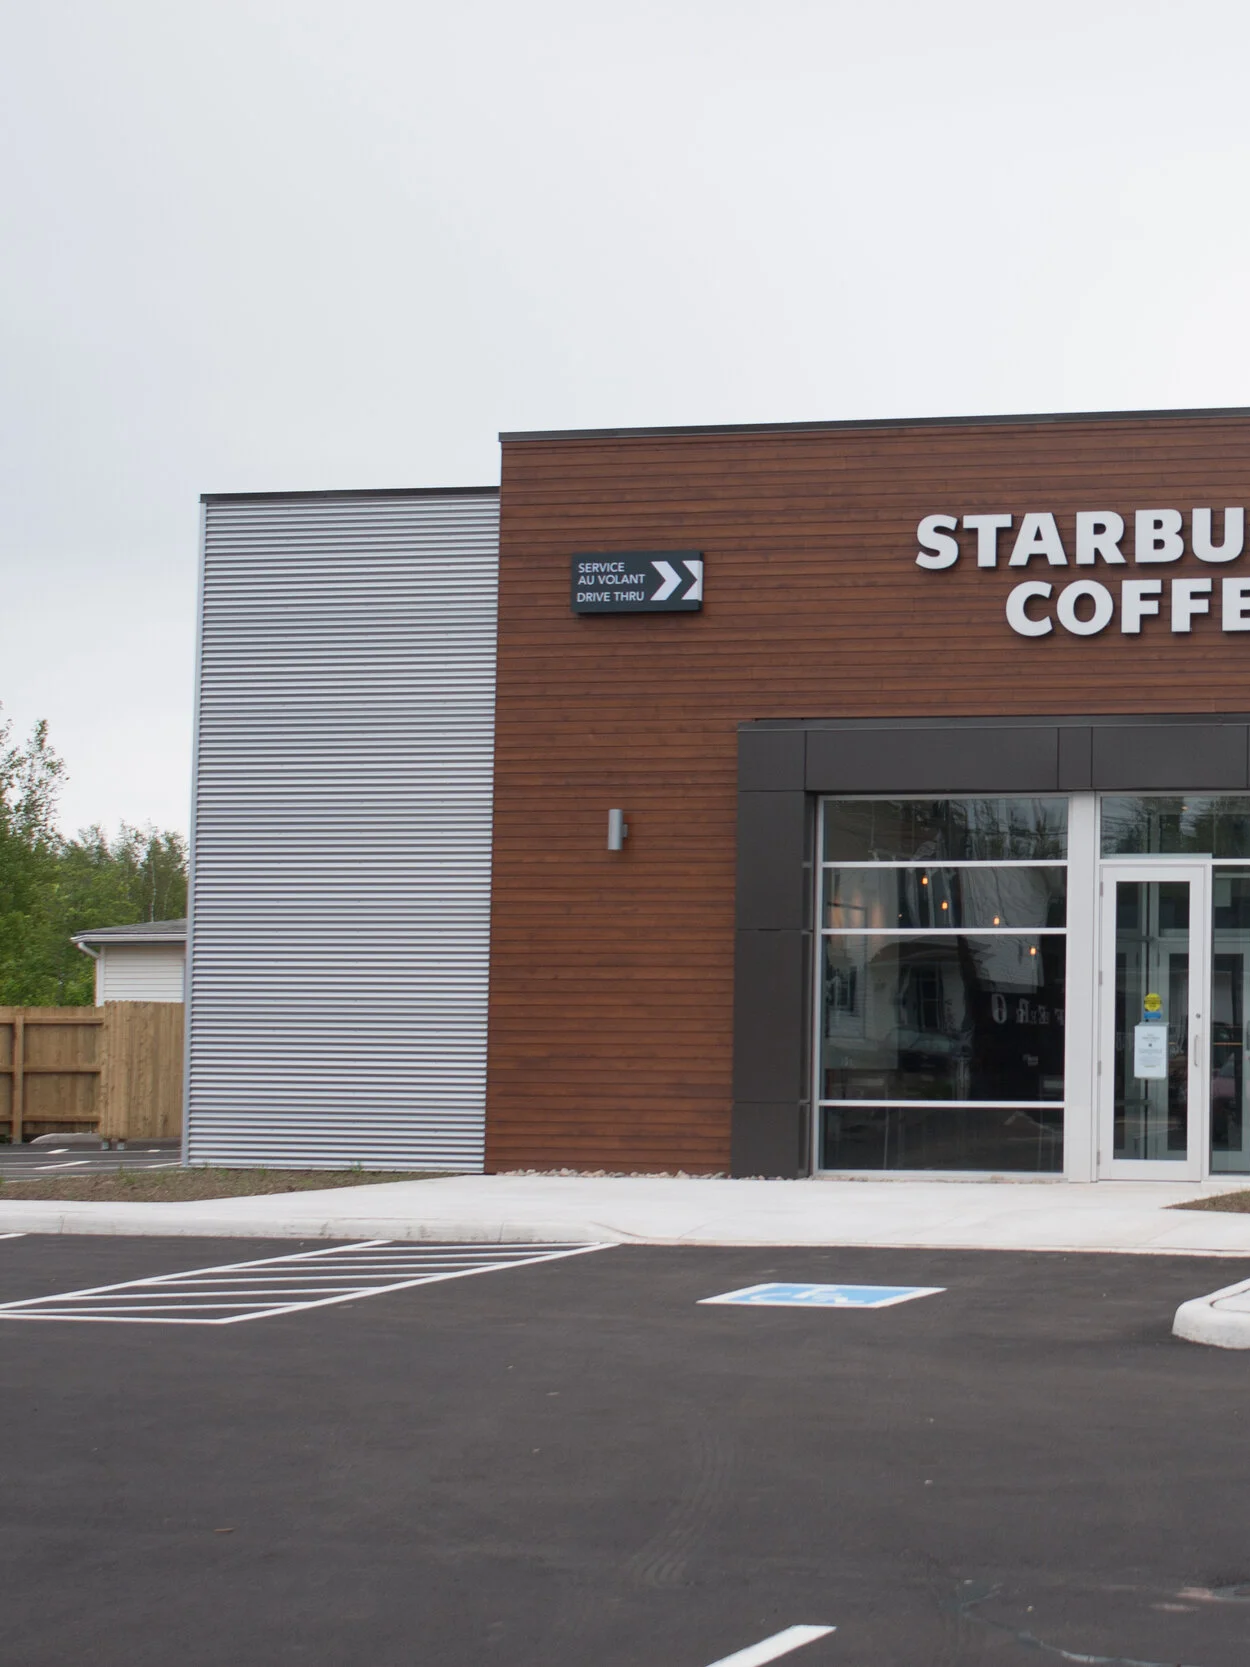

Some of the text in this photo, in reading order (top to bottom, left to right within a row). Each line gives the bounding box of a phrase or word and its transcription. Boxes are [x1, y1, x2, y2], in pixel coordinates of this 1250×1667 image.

[578, 562, 625, 573] SERVICE
[577, 573, 646, 585] AU VOLANT
[576, 591, 645, 602] DRIVE THRU
